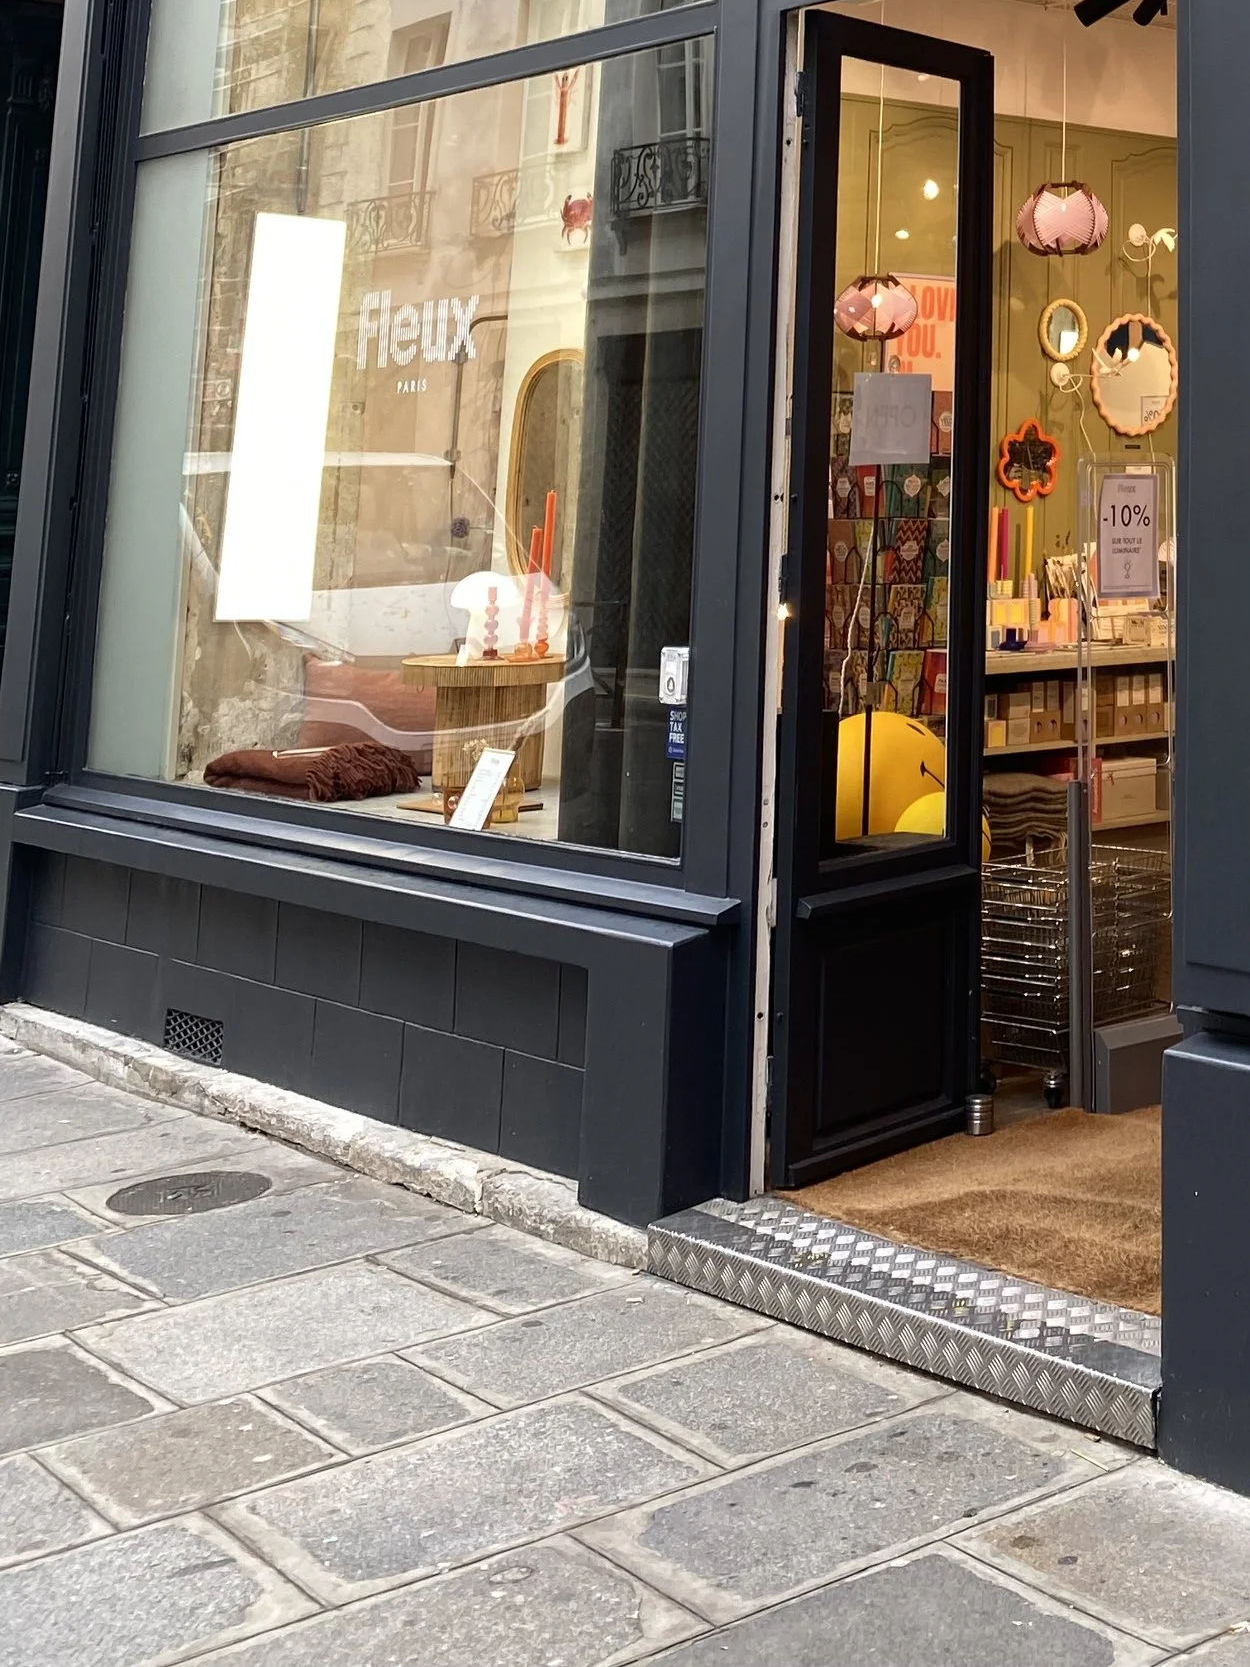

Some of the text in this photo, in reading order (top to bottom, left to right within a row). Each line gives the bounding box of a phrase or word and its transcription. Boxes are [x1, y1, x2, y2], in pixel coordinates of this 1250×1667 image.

[396, 379, 427, 394] PARIS
[1102, 504, 1151, 527] -10%
[670, 710, 687, 722] SHOP
[669, 721, 683, 733] TAX
[668, 732, 685, 744] FREE
